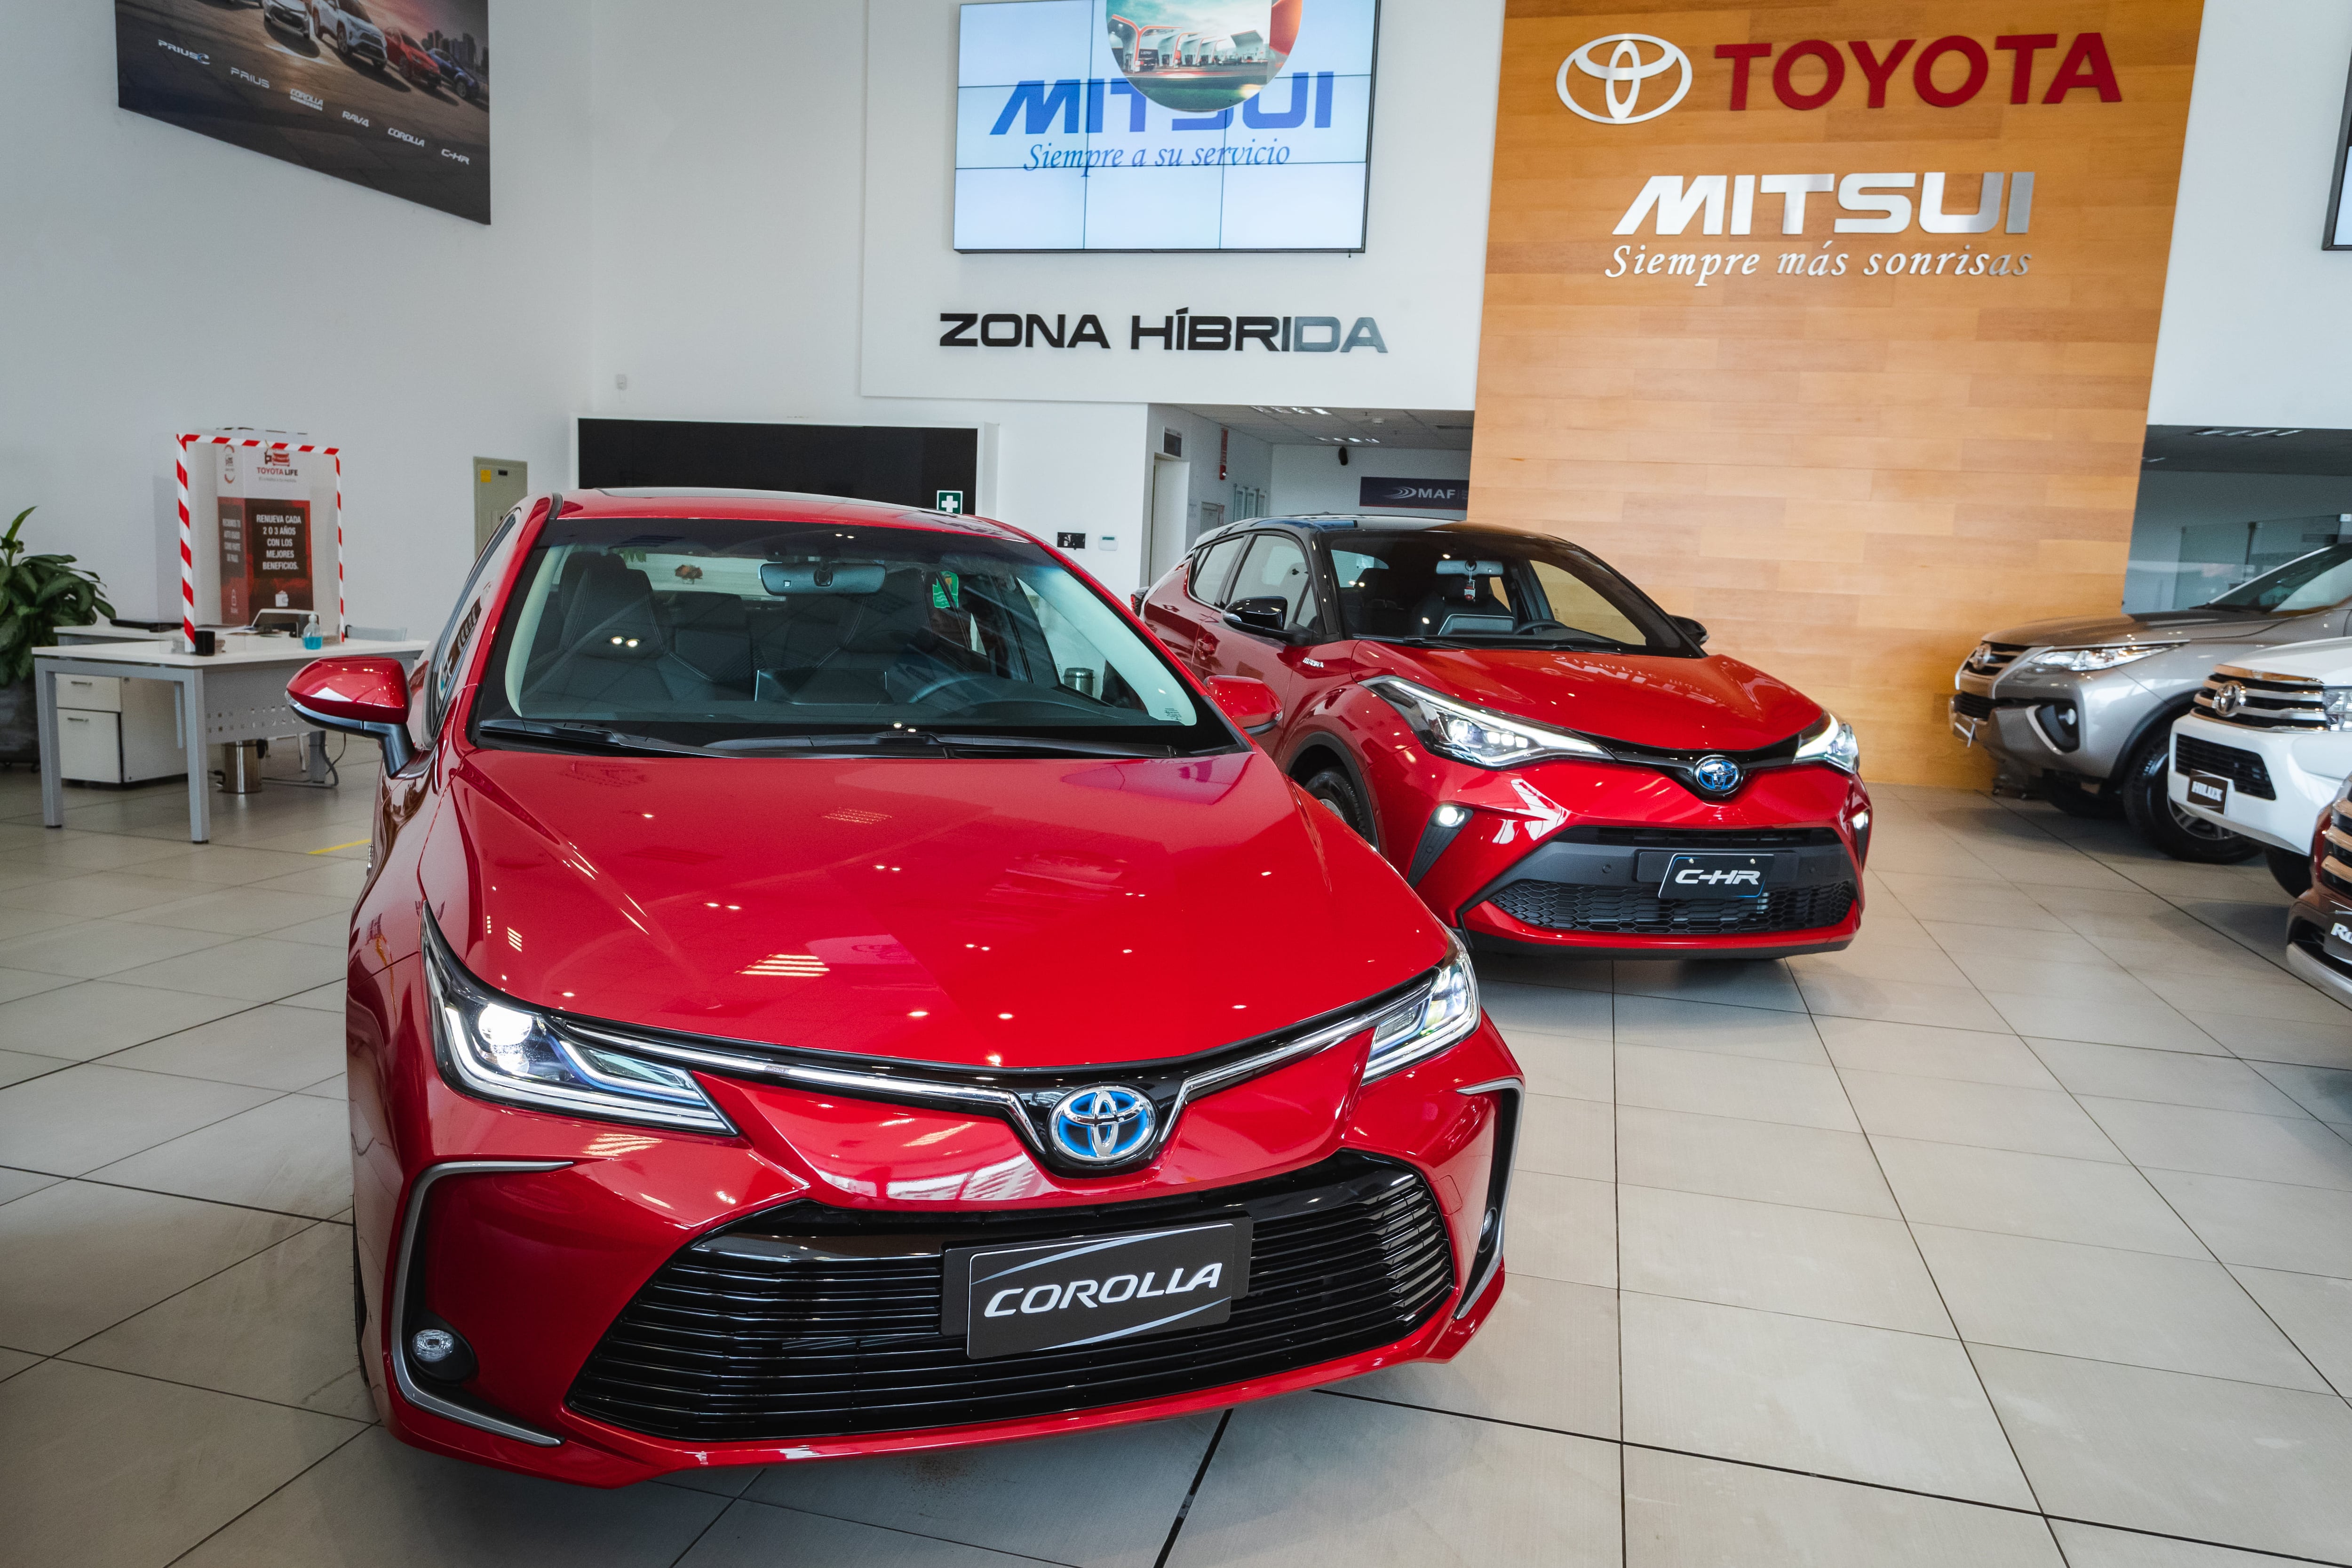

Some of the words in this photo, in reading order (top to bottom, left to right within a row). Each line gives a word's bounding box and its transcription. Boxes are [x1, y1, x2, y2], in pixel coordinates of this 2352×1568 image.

[230, 67, 270, 88] PRIUS
[1714, 32, 2122, 111] TOYOTA
[290, 88, 323, 106] COROLLA
[342, 111, 369, 127] RAV4
[388, 127, 425, 147] COROLLA
[441, 148, 469, 165] C-HR
[1023, 143, 1124, 177] Siempre
[1131, 150, 1147, 167] a
[1154, 150, 1184, 167] su
[1194, 138, 1290, 167] servicio
[1612, 172, 2035, 236] MITSUI
[1605, 244, 1760, 287] Siempre
[1777, 240, 1849, 277] más
[1863, 245, 2032, 277] sonrisas
[939, 313, 1111, 349] ZONA
[1130, 307, 1389, 353] HÍBRIDA
[1418, 488, 1456, 499] MAF
[256, 514, 284, 523] RENUEVA
[279, 525, 296, 535] AÑOS
[281, 539, 293, 547] LOS
[266, 550, 294, 558] MEJORES
[262, 562, 299, 570] BENEFICIOS.
[2192, 781, 2223, 802] HILUX
[1675, 869, 1761, 885] C-HR
[984, 1263, 1223, 1317] COROLLA
